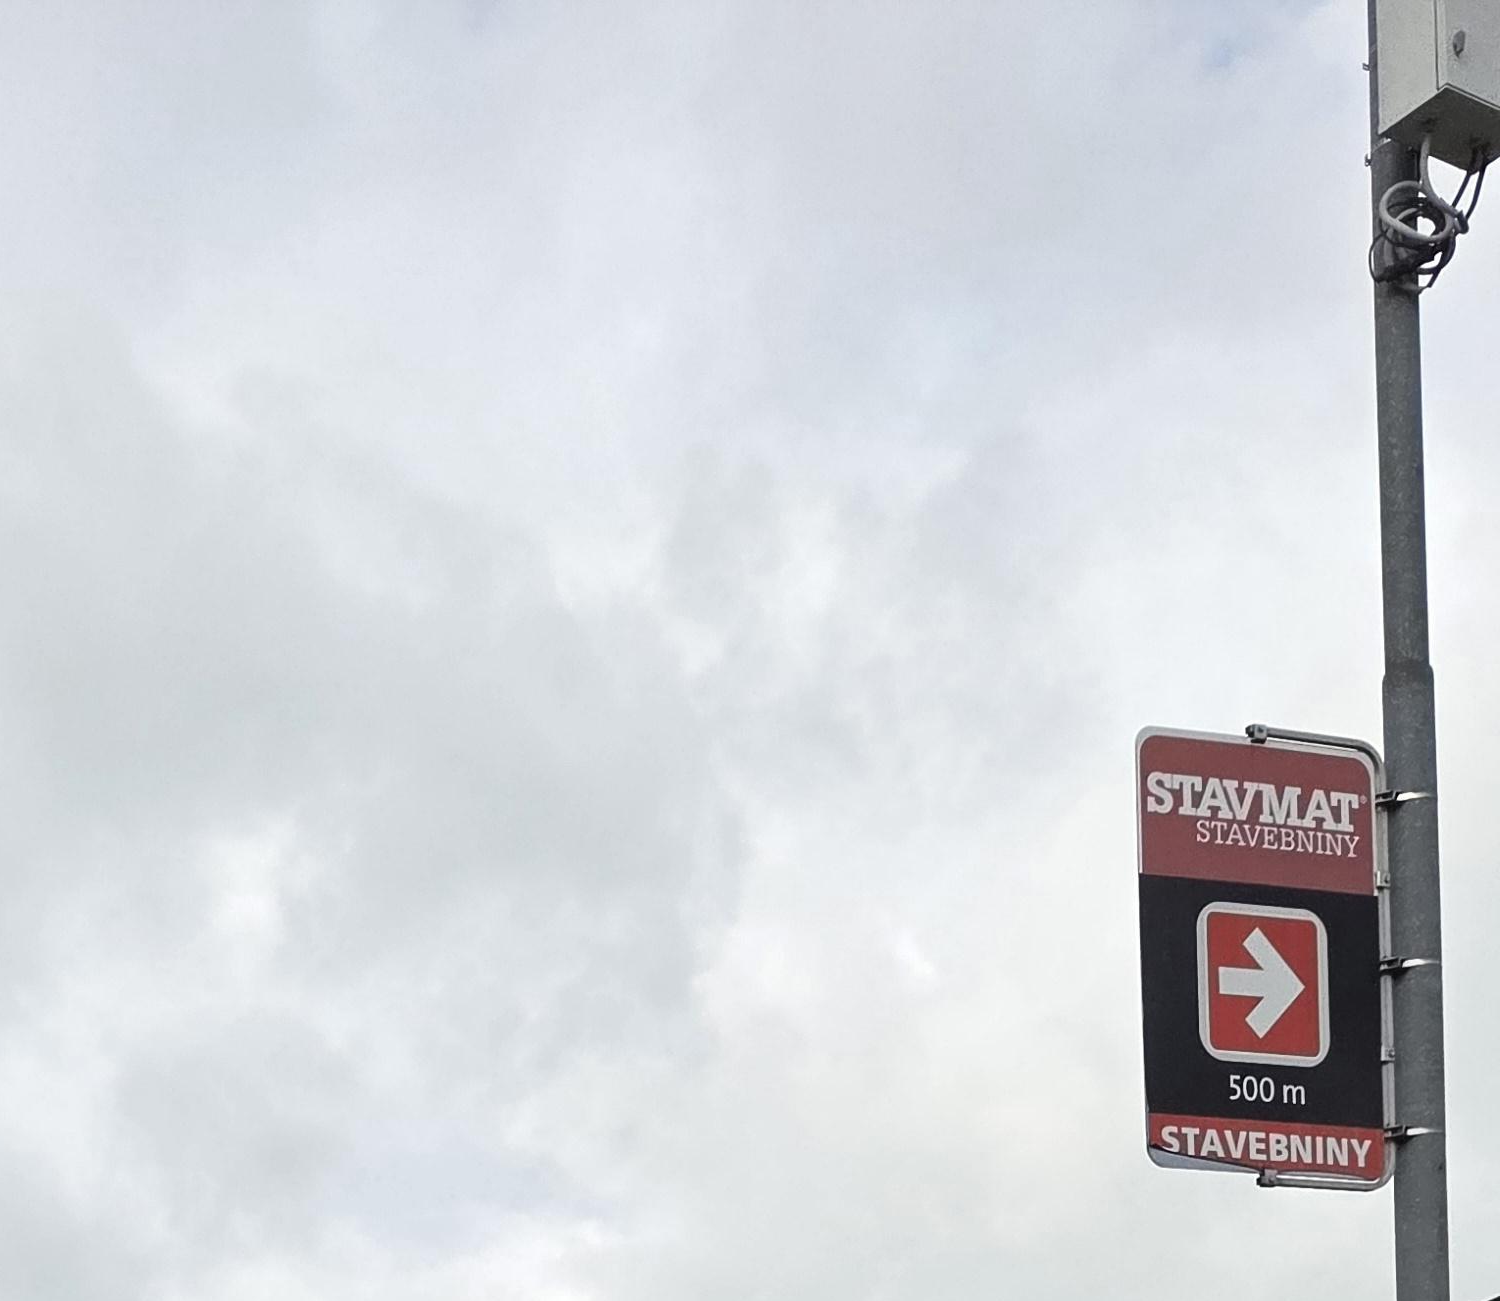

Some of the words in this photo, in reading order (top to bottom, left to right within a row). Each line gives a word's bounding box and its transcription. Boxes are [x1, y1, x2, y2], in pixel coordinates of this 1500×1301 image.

[1146, 772, 1360, 832] STAVMAT
[1196, 821, 1360, 858] STAVEBNINY
[1228, 1074, 1276, 1103] 500
[1282, 1083, 1306, 1105] m
[1160, 1125, 1372, 1168] STAVEBNINY
